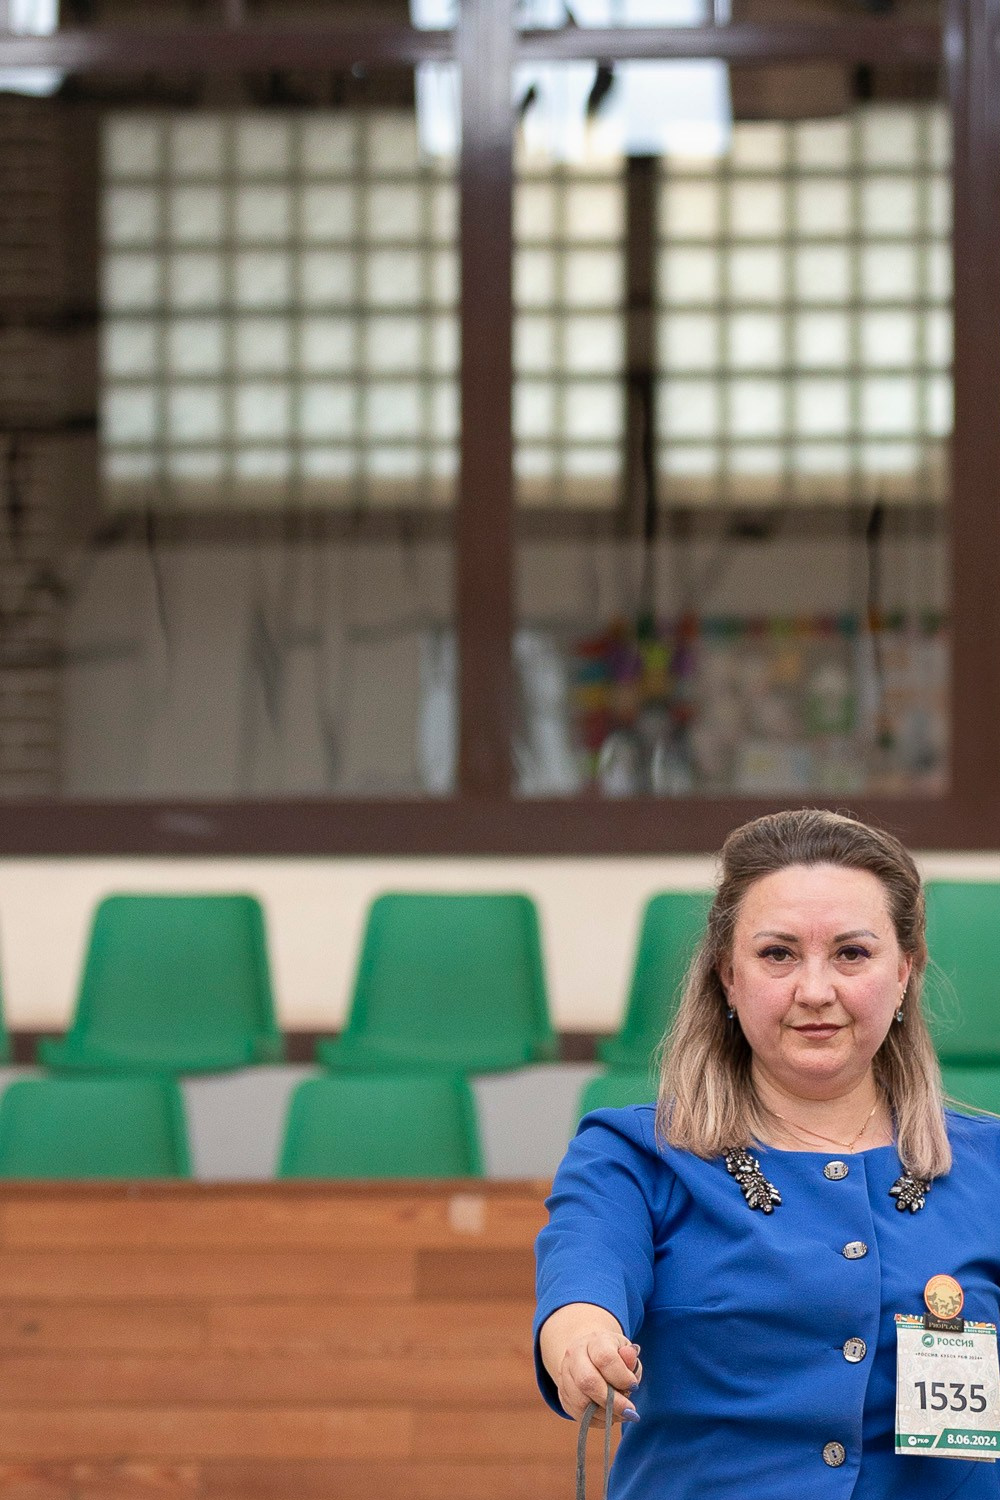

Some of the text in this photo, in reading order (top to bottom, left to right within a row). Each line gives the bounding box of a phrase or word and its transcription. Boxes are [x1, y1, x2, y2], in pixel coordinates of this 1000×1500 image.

[937, 1337, 974, 1348] РОССИЯ
[914, 1380, 987, 1413] 1535
[947, 1433, 997, 1446] 8.06.2024
